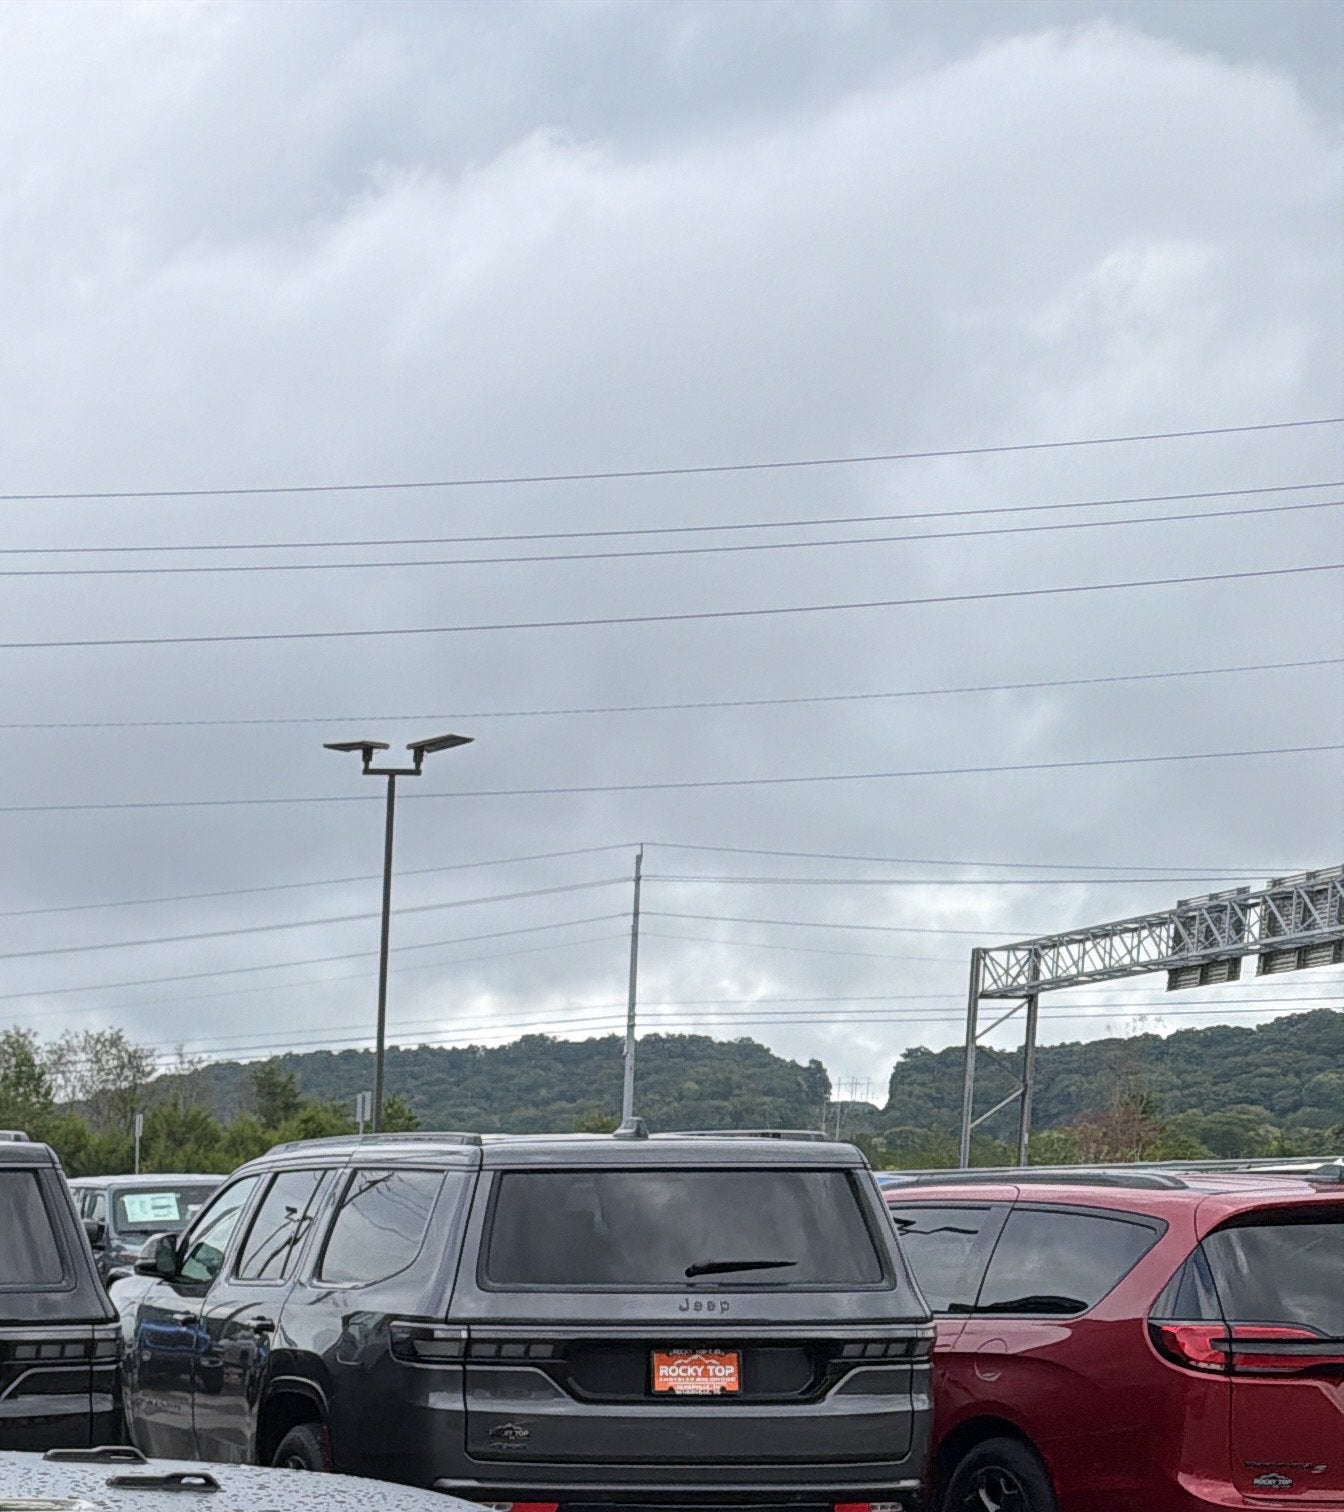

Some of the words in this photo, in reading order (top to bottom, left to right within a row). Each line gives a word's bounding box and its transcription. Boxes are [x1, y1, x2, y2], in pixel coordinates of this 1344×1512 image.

[678, 1298, 730, 1314] Jeep
[659, 1365, 705, 1377] ROCKY
[706, 1365, 736, 1377] TOP
